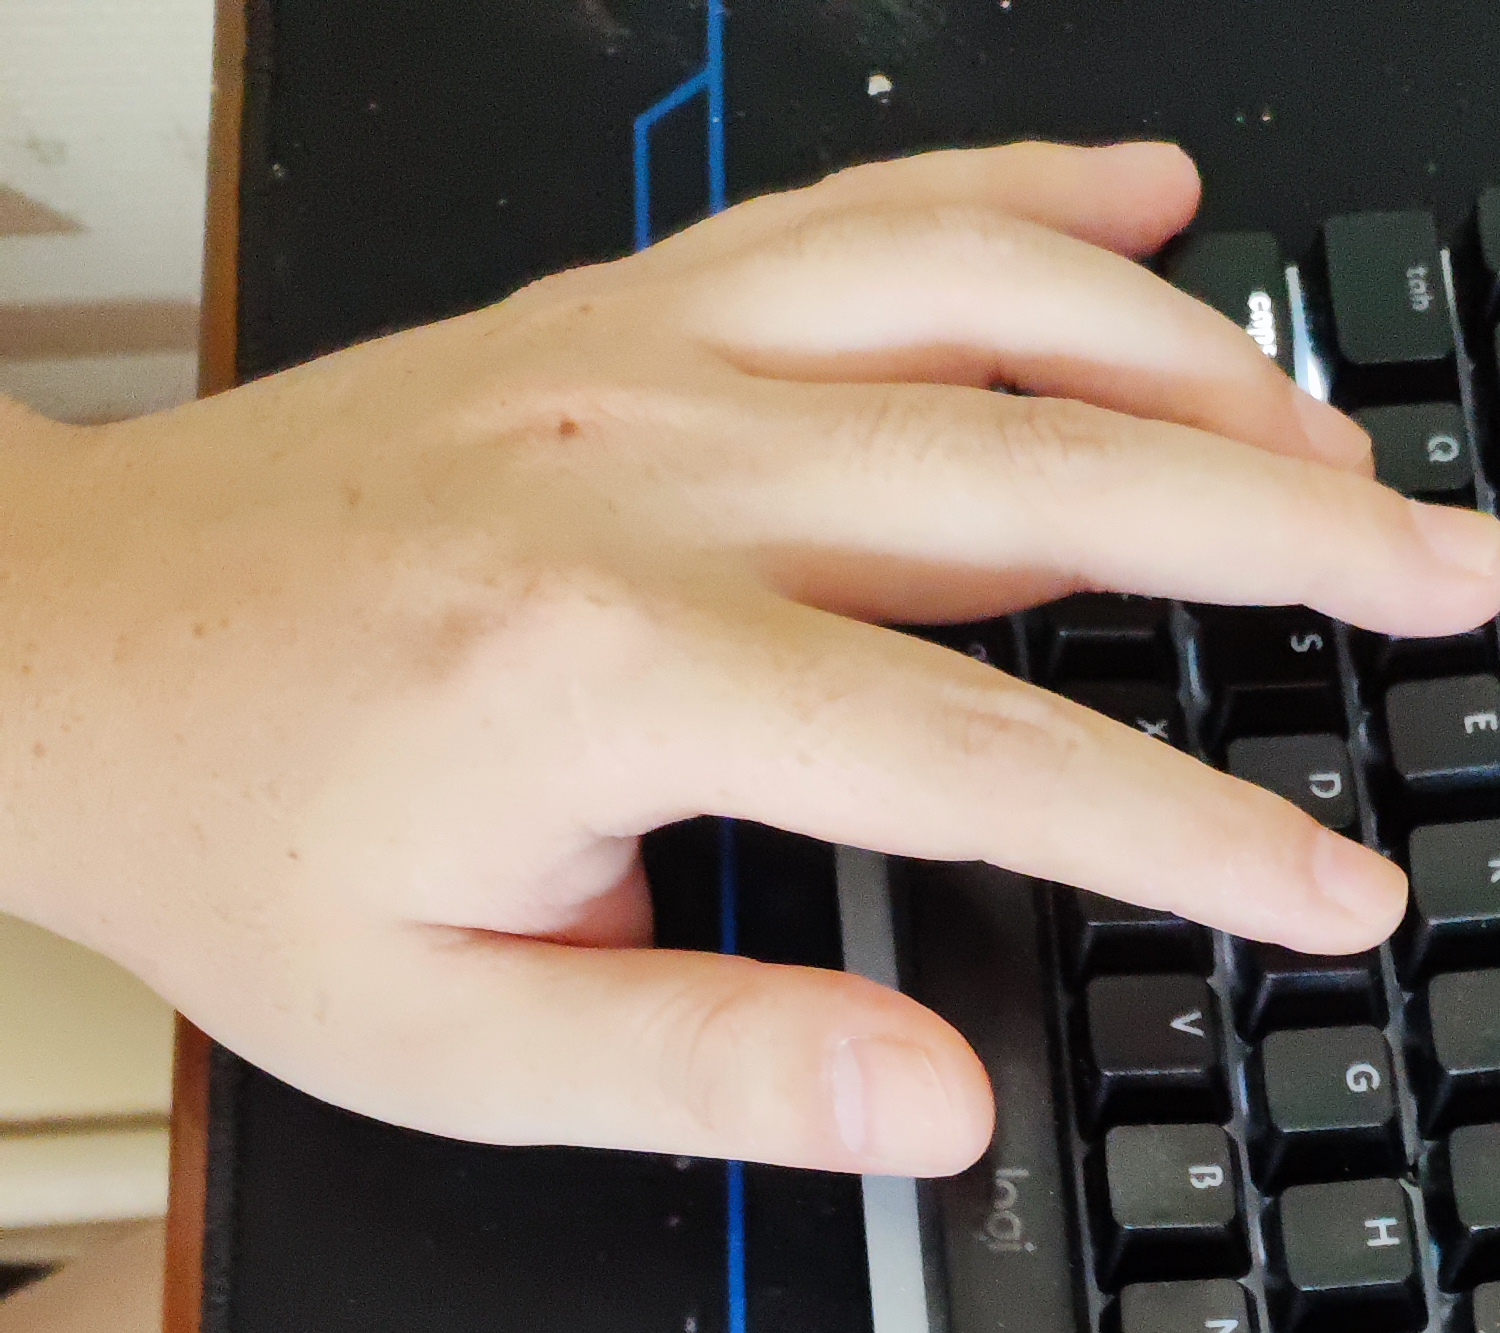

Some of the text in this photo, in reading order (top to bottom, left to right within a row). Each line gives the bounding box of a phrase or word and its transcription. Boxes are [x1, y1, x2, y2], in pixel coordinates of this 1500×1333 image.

[1406, 265, 1433, 312] tab
[1427, 434, 1460, 463] Q
[1290, 633, 1323, 653] S
[1463, 712, 1499, 734] E
[1308, 771, 1342, 799] D
[1170, 1011, 1204, 1037] V
[1345, 1063, 1381, 1093] G
[1188, 1164, 1224, 1190] B
[977, 1168, 1034, 1252] logi
[1364, 1217, 1400, 1247] H
